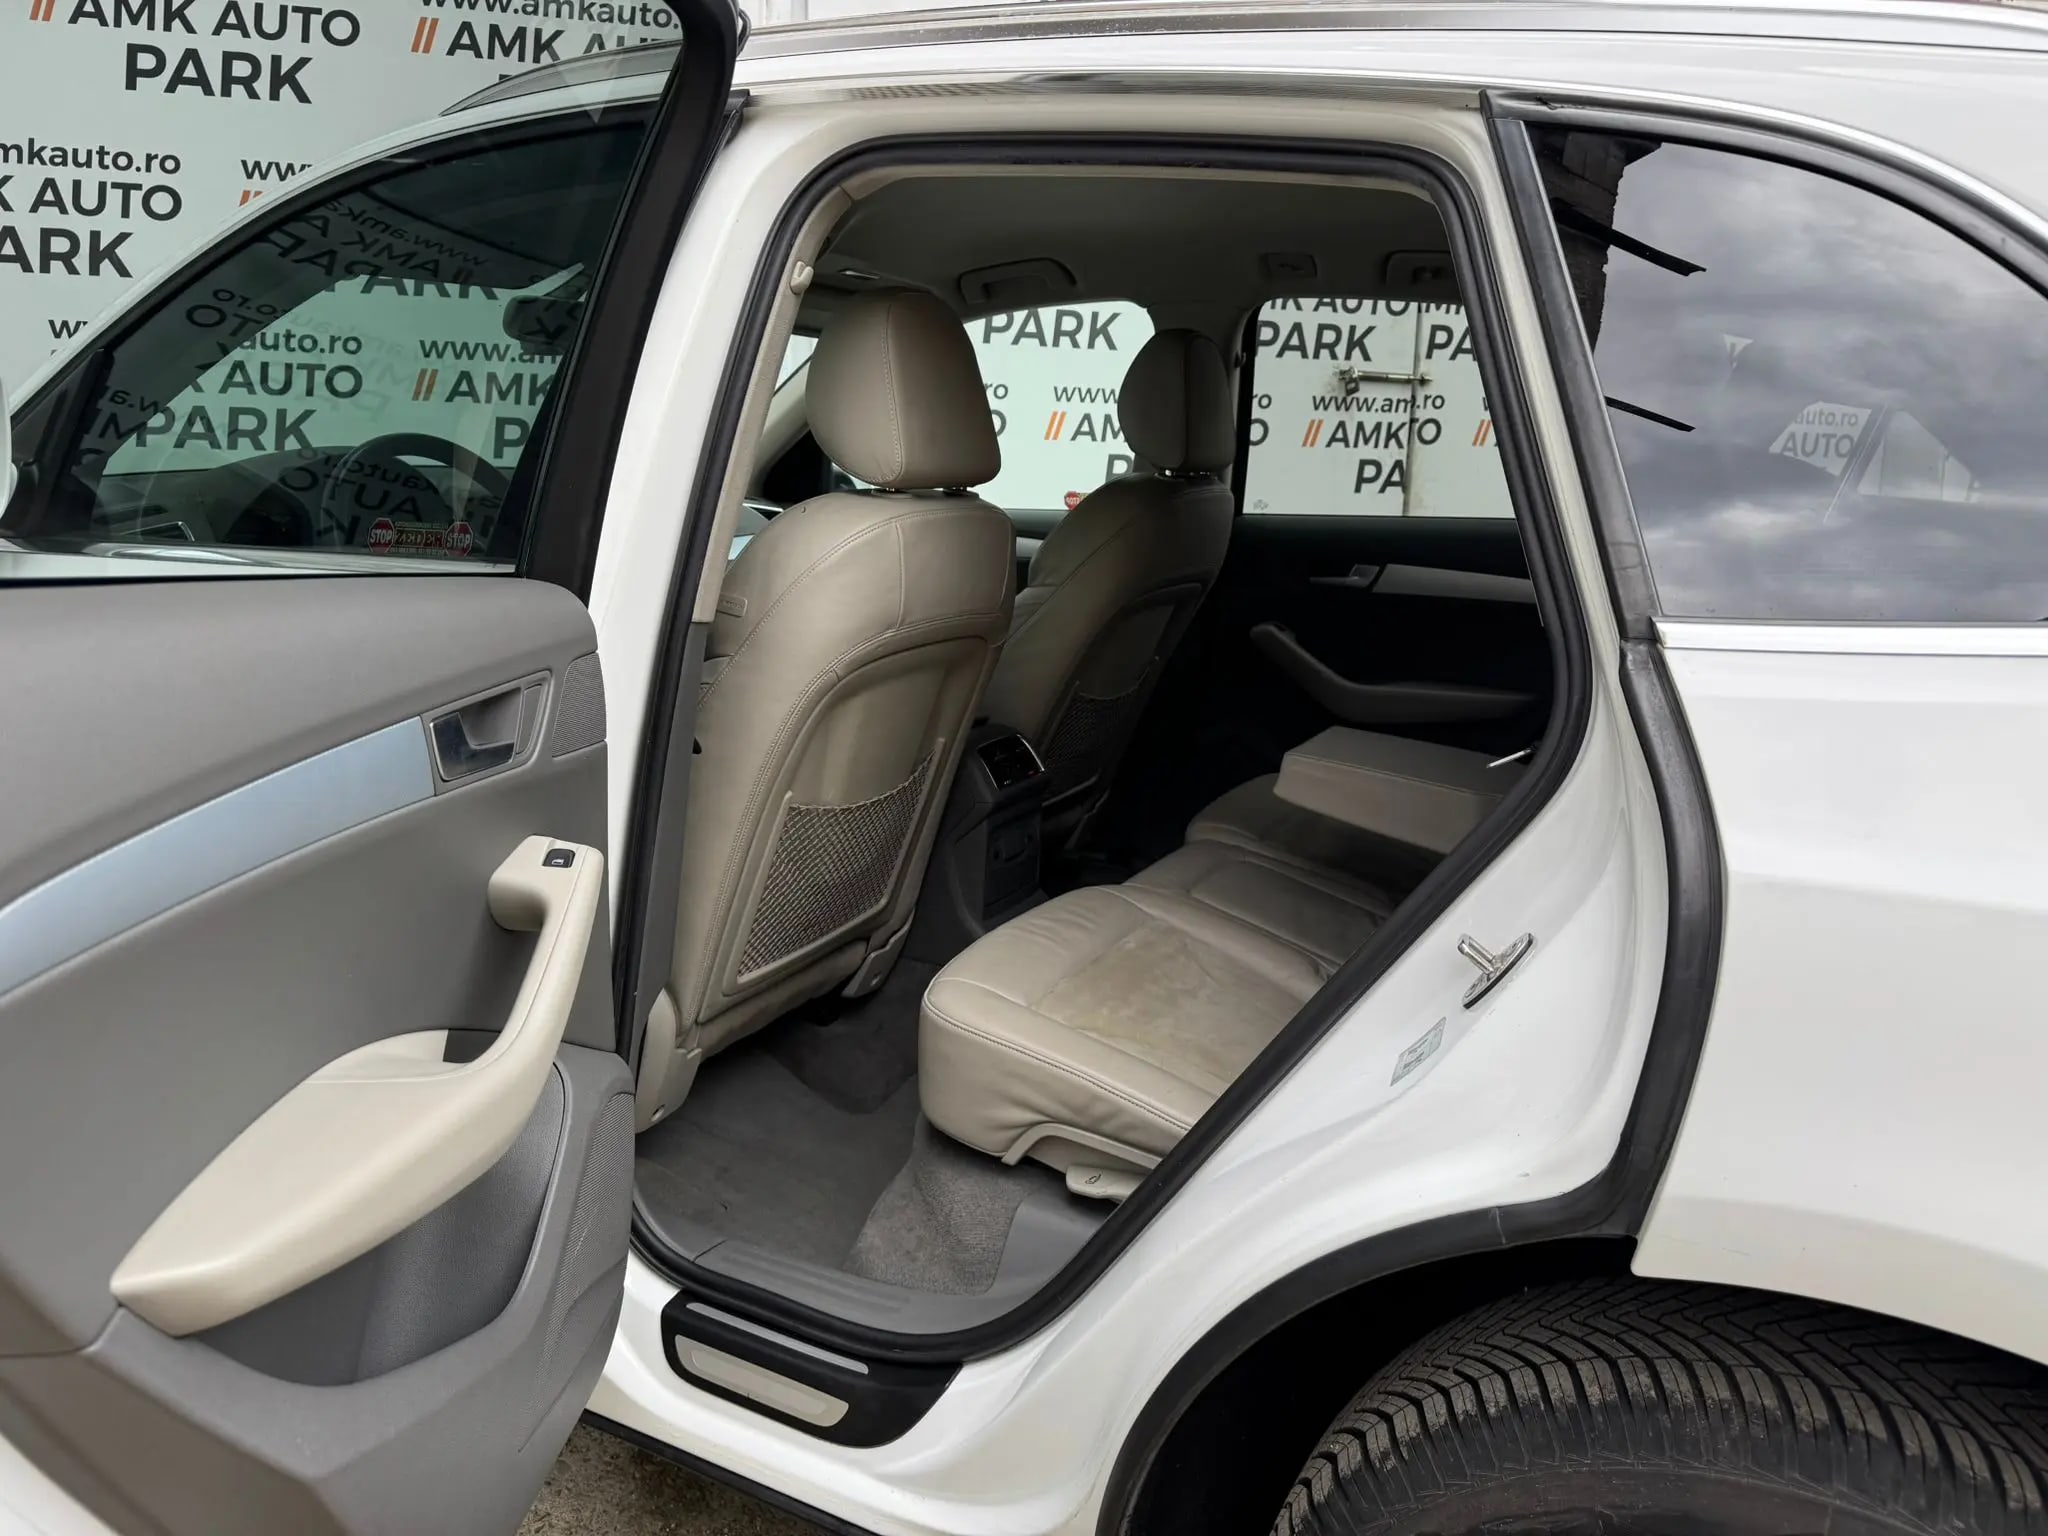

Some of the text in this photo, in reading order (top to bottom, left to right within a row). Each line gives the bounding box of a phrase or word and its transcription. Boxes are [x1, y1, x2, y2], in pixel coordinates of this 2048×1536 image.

[67, 0, 360, 46] AMK AUTO
[446, 21, 566, 63] AMK
[125, 43, 313, 104] PARK
[28, 177, 182, 221] AUTO
[982, 308, 1122, 351] PARK
[1255, 320, 1376, 362] PARK
[218, 359, 363, 399] AUTO
[135, 405, 317, 451] PARK
[369, 528, 393, 544] STOP
[447, 533, 471, 548] STOP
